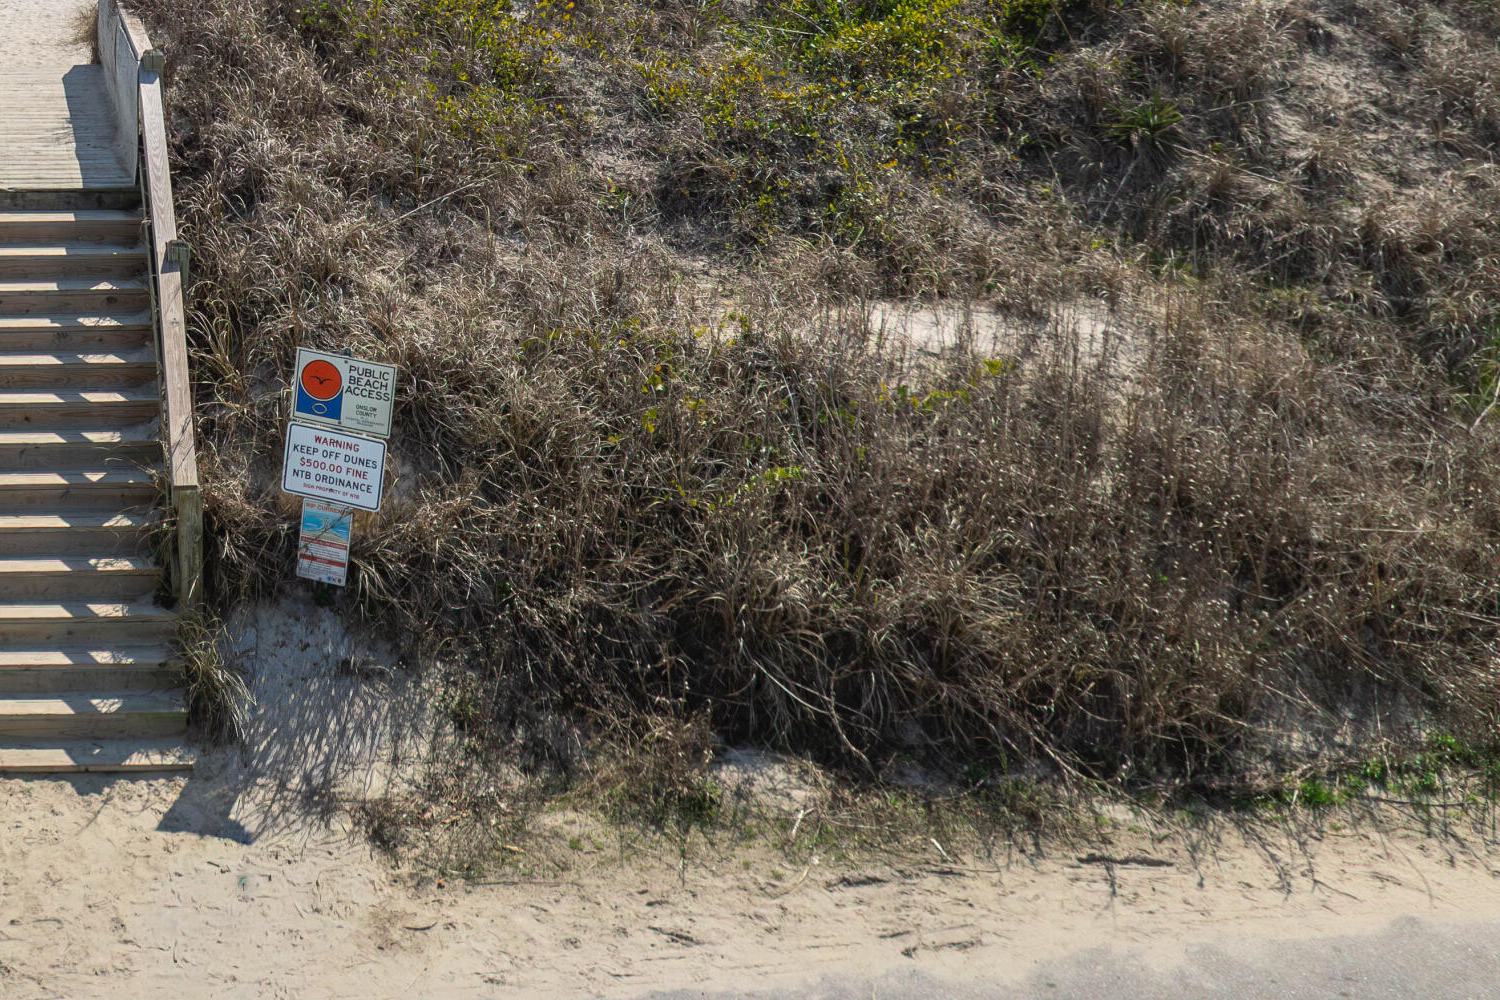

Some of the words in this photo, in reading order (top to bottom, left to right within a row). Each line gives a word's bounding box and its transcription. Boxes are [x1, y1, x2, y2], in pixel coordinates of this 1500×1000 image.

[349, 365, 390, 381] PUBLIC
[349, 376, 388, 391] BEACH
[345, 385, 390, 402] ACCESS
[356, 404, 377, 412] ONSLOW
[356, 410, 377, 419] COUNTY
[314, 435, 360, 453] WARNING
[293, 444, 318, 456] KEEP
[322, 449, 341, 460] OFF
[344, 454, 378, 469] DUNES
[300, 457, 342, 474] $500.00
[346, 467, 368, 480] FINE
[292, 468, 311, 480] NTB
[314, 473, 372, 493] ORDINANCE
